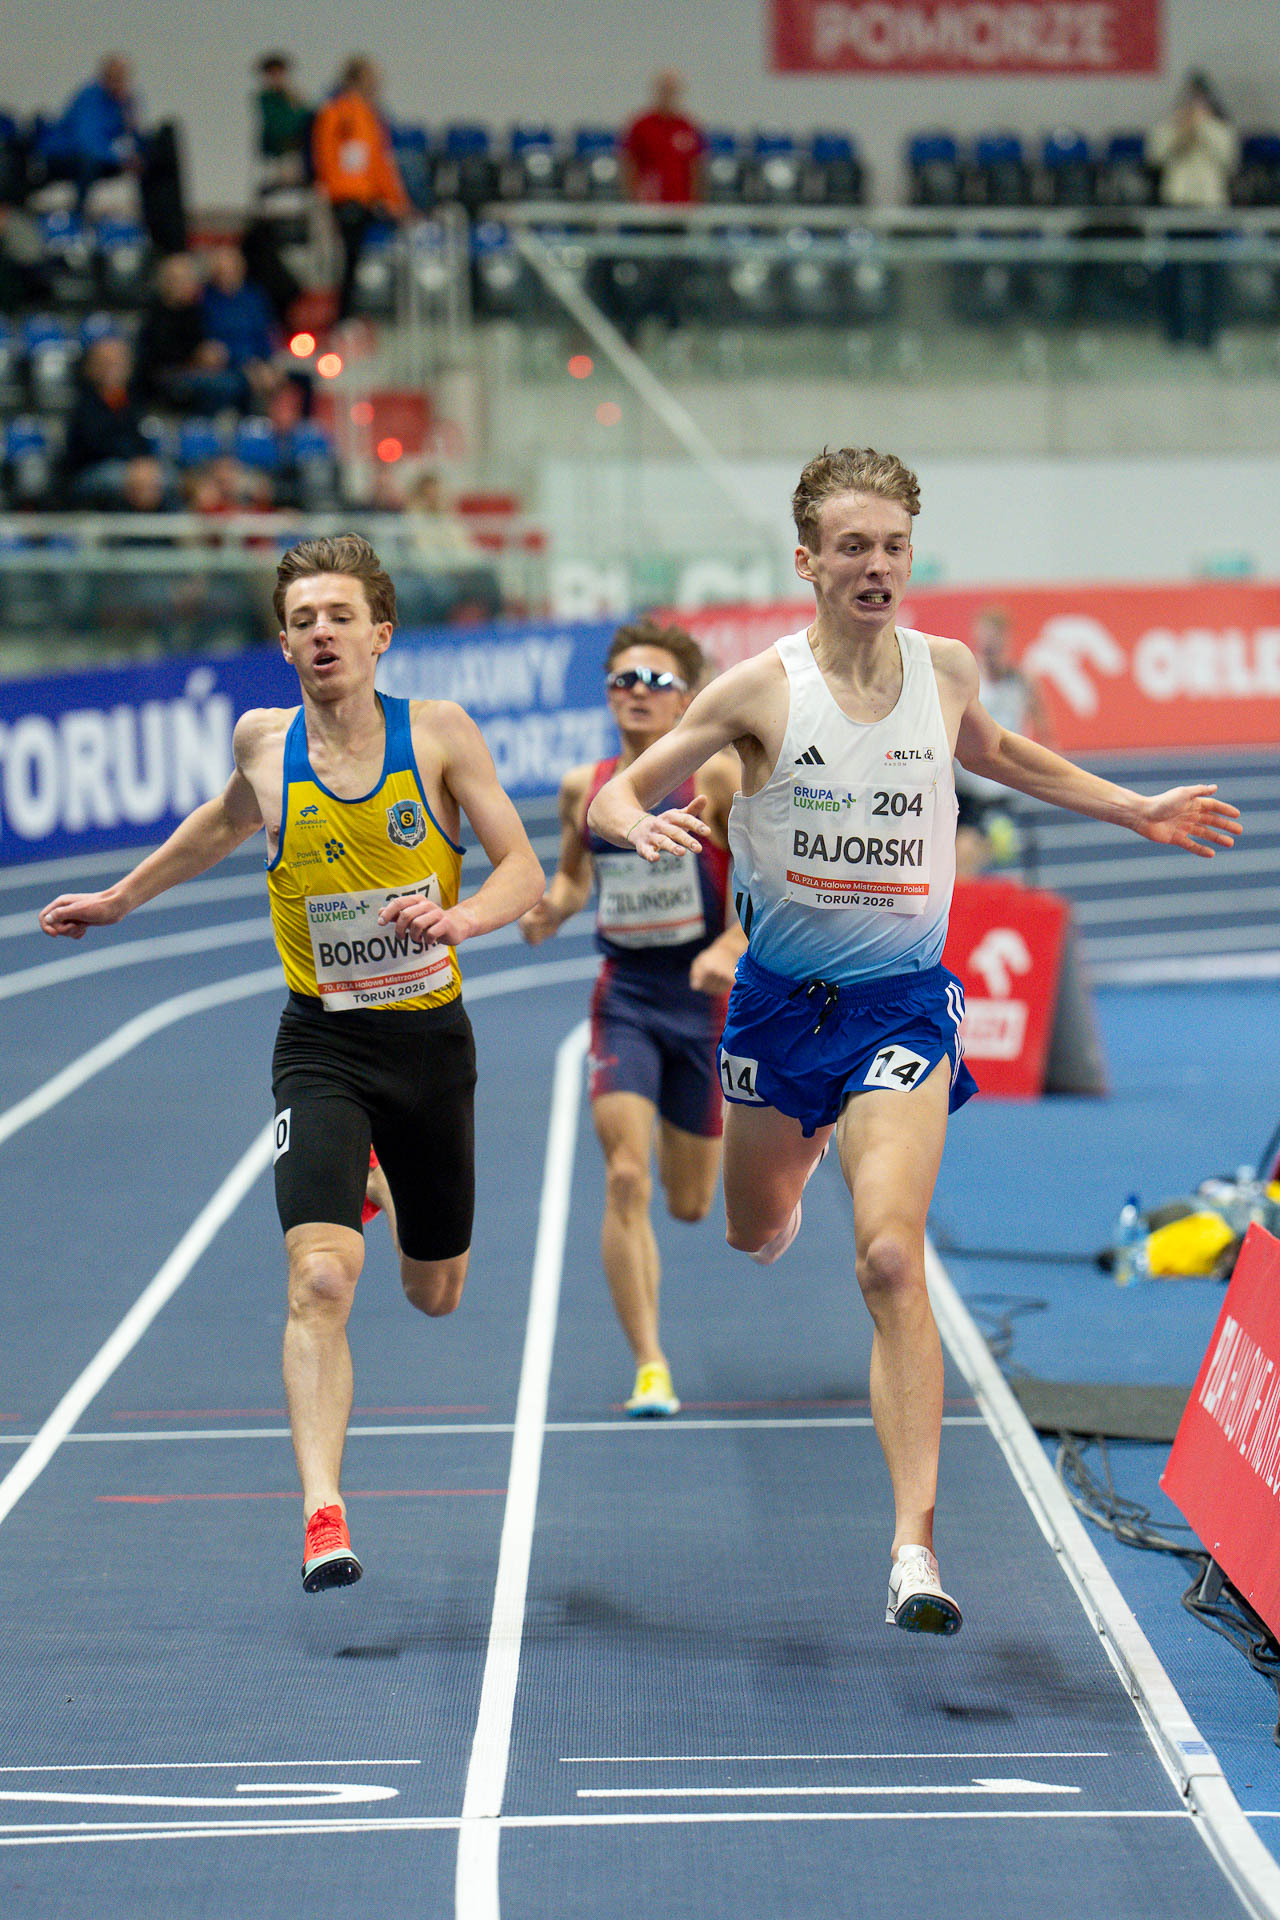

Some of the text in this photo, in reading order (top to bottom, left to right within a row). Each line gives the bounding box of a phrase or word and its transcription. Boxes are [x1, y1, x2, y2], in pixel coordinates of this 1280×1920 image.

[812, 0, 1119, 63] POMORZE
[793, 786, 834, 801] GRUPA
[793, 796, 840, 813] LUXMED
[871, 791, 923, 817] 204
[793, 829, 924, 867] BAJORSKI
[791, 873, 925, 894] 70. PZLA Halowe Mistrzostwa Polski
[309, 901, 348, 913] GRUPA
[815, 892, 895, 908] TORUŃ 2026
[310, 910, 356, 923] LUXMED
[319, 932, 440, 967] BOROWS
[354, 979, 384, 989] Halowe
[384, 969, 429, 984] Mistrzostwa
[428, 960, 447, 976] Polski
[353, 986, 396, 1003] TORUŃ
[397, 982, 426, 997] 2026
[721, 1059, 756, 1097] 14
[875, 1050, 922, 1086] 14
